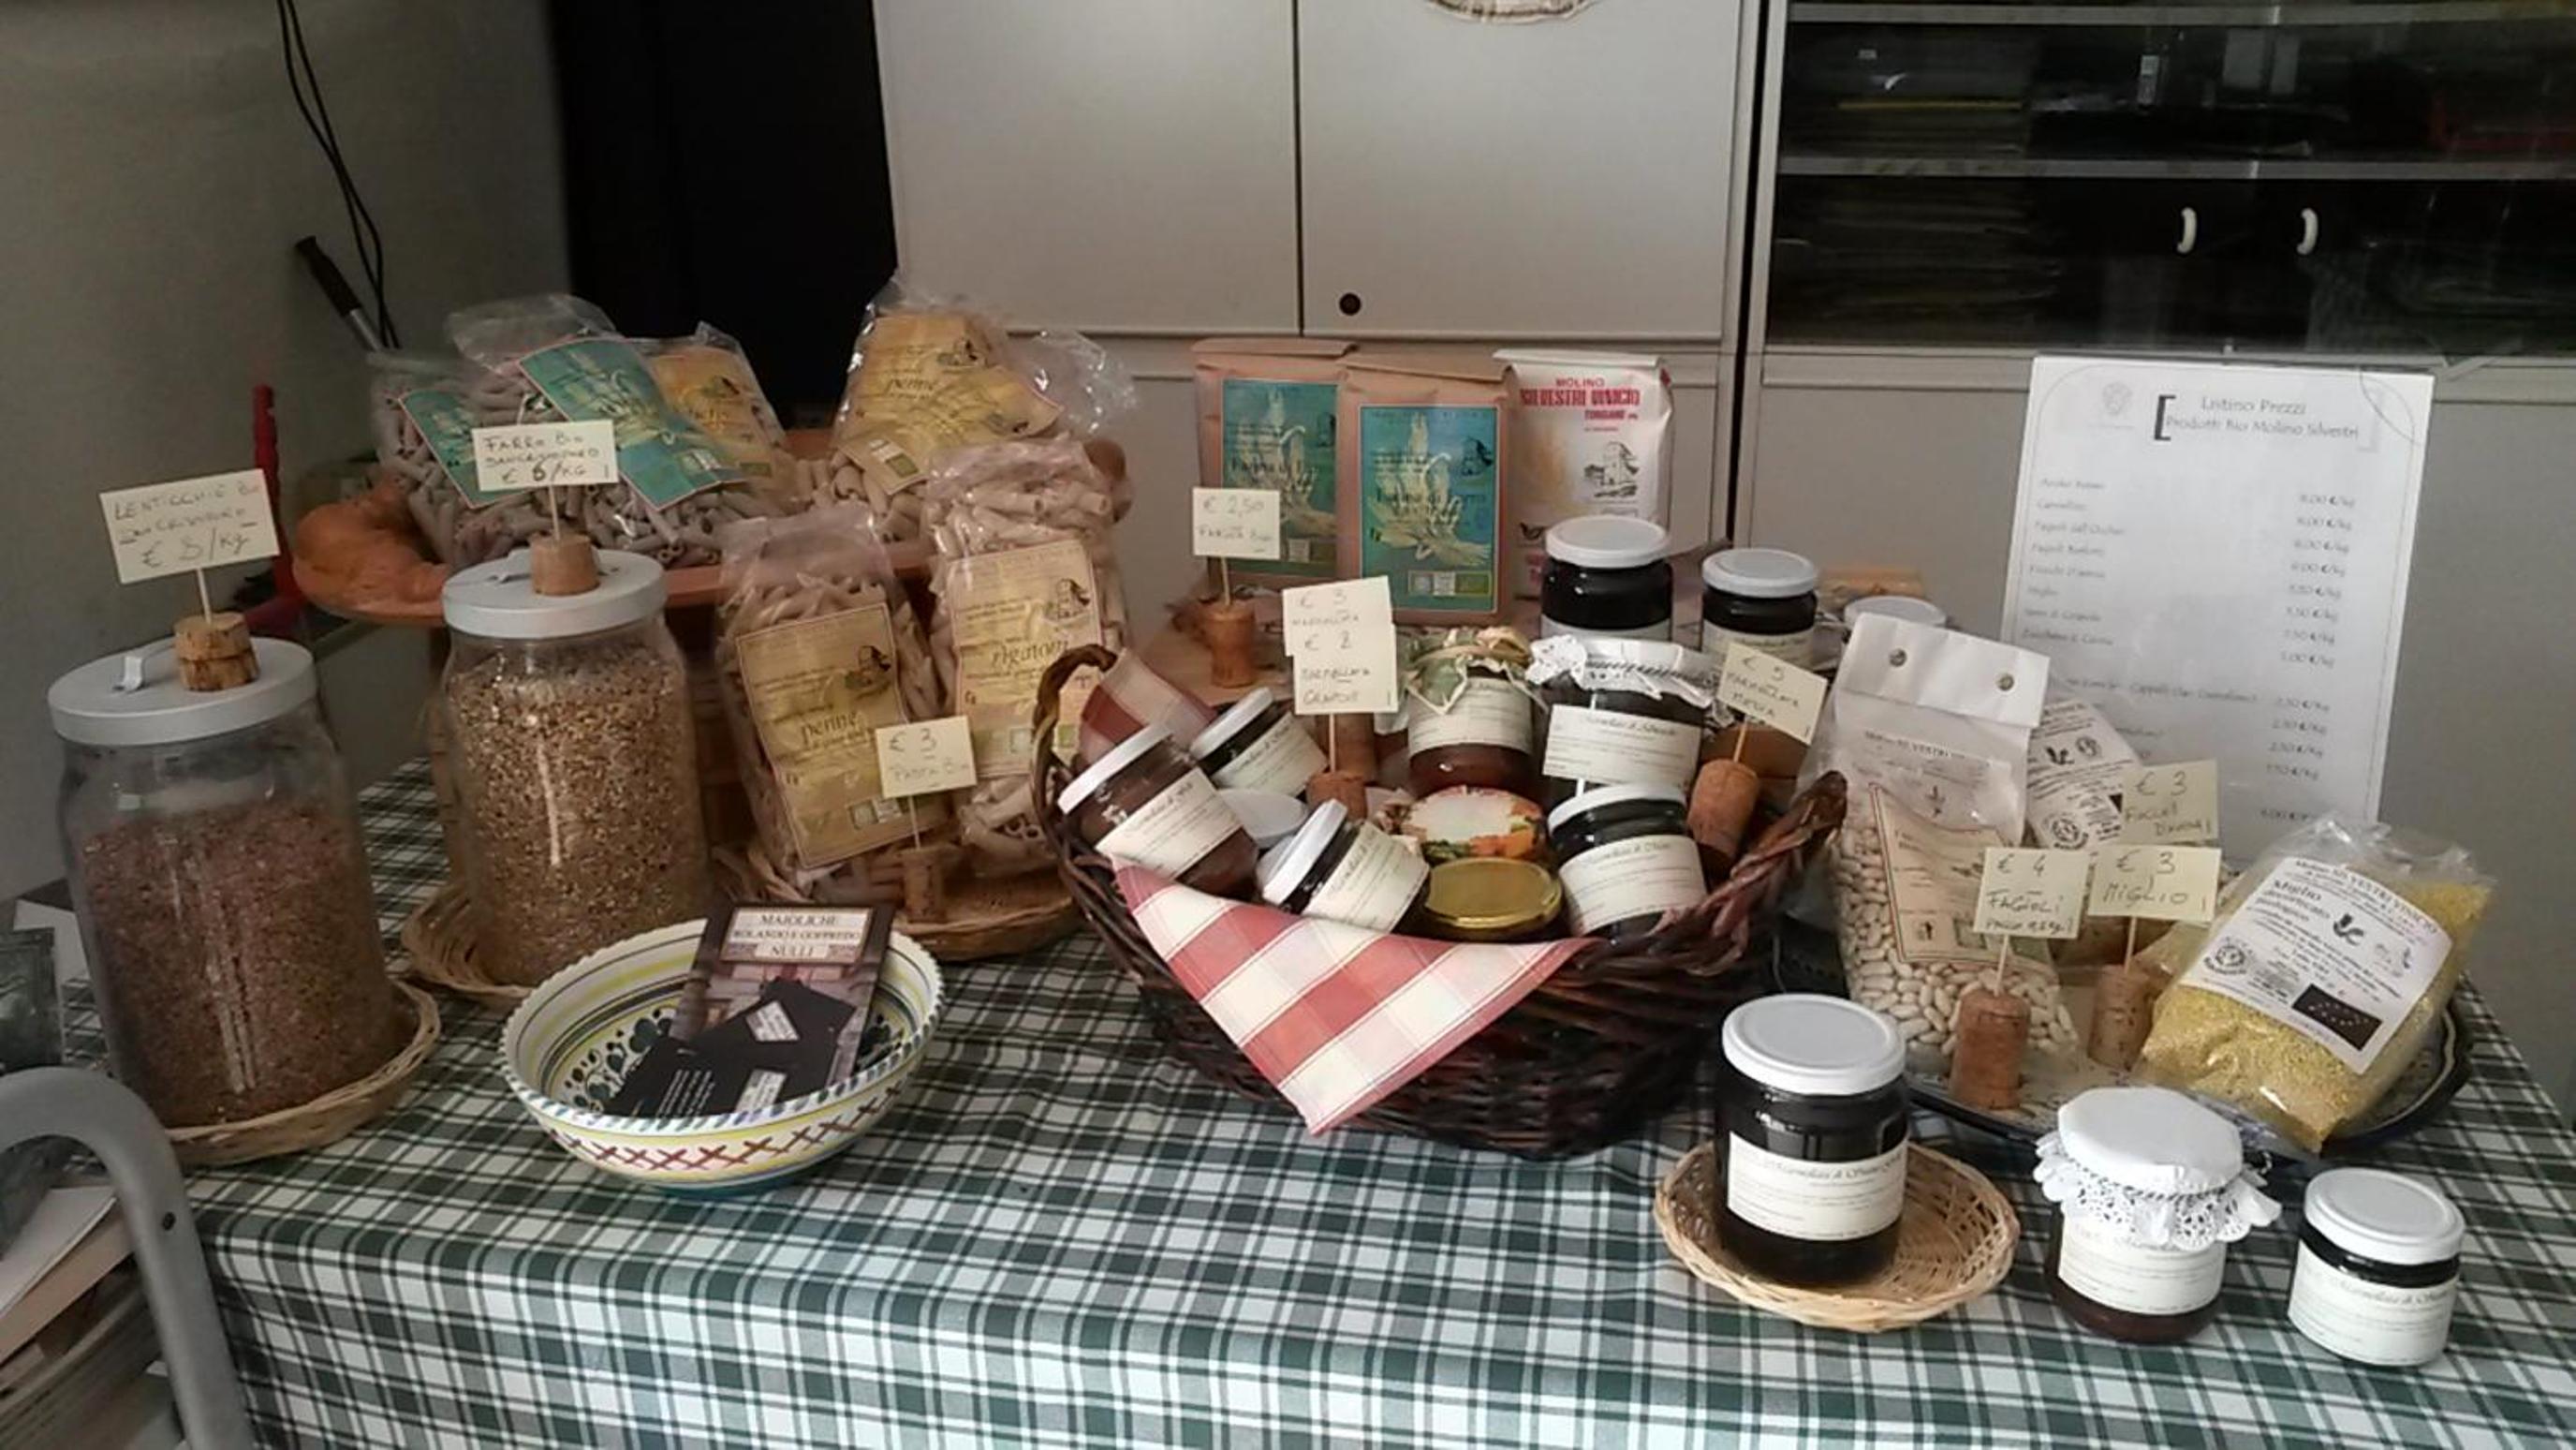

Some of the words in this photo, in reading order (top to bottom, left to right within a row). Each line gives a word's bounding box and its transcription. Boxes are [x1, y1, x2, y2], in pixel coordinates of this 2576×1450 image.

[1555, 377, 1605, 387] MOLINO
[1520, 389, 1587, 407] SILVESTRI
[1591, 389, 1641, 407] VINICIO
[2201, 394, 2256, 413] Listino
[2260, 397, 2307, 417] Prezzi
[2164, 415, 2219, 434] Prodotti
[2251, 418, 2304, 437] Molino
[2306, 420, 2360, 439] Silvestri
[483, 435, 545, 451] FARRO
[2136, 771, 2156, 796] €
[2170, 771, 2187, 797] 3
[1996, 853, 2014, 875] €
[2032, 854, 2046, 877] 4
[2114, 849, 2142, 874] €
[2156, 851, 2176, 876] 3
[2102, 877, 2189, 909] MIGLIO
[760, 914, 837, 925] MAIOLICHE
